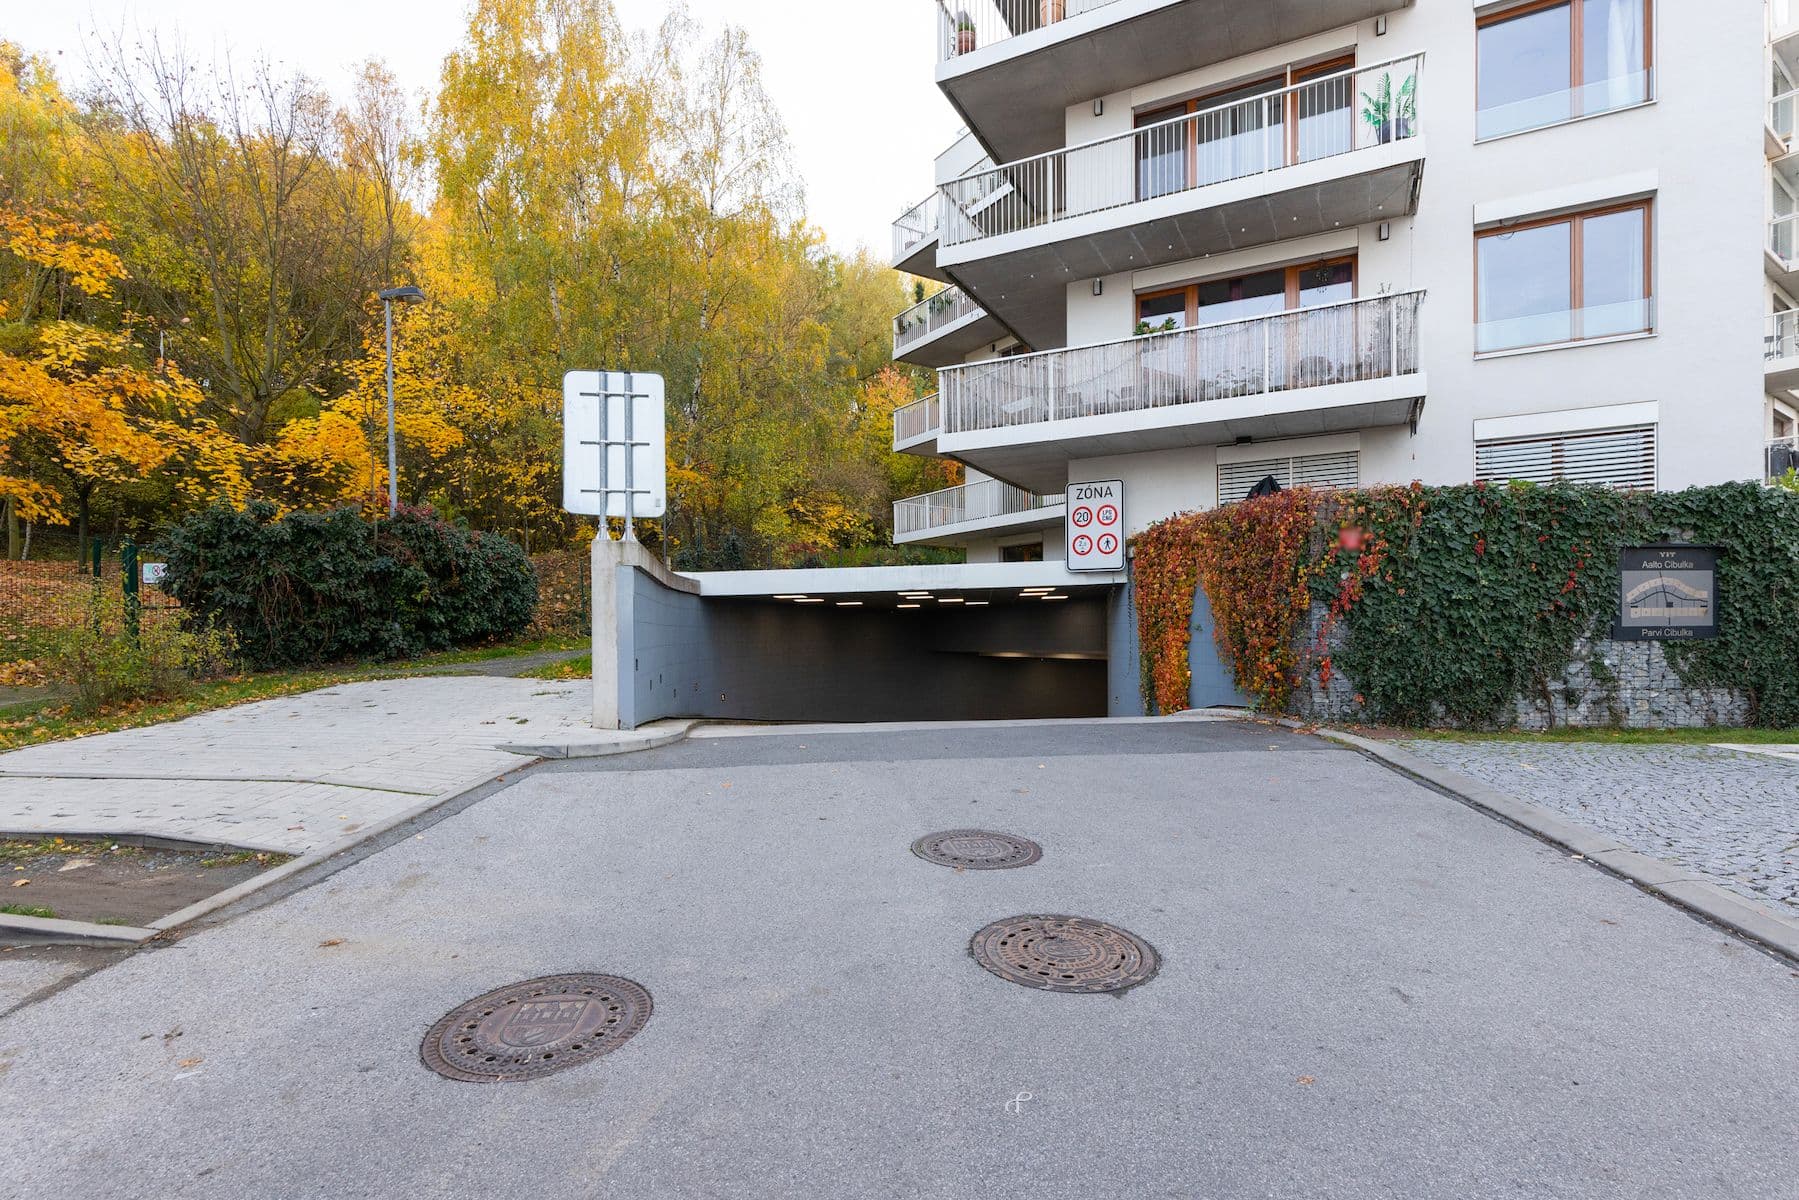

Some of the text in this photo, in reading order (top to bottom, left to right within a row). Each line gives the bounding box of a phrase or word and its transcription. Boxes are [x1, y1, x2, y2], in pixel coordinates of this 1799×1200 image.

[1076, 485, 1113, 500] ZÓNA
[1076, 511, 1088, 523] 20
[1642, 560, 1694, 569] Aalto Cibulka
[1642, 628, 1694, 637] Parvi Cibulka
